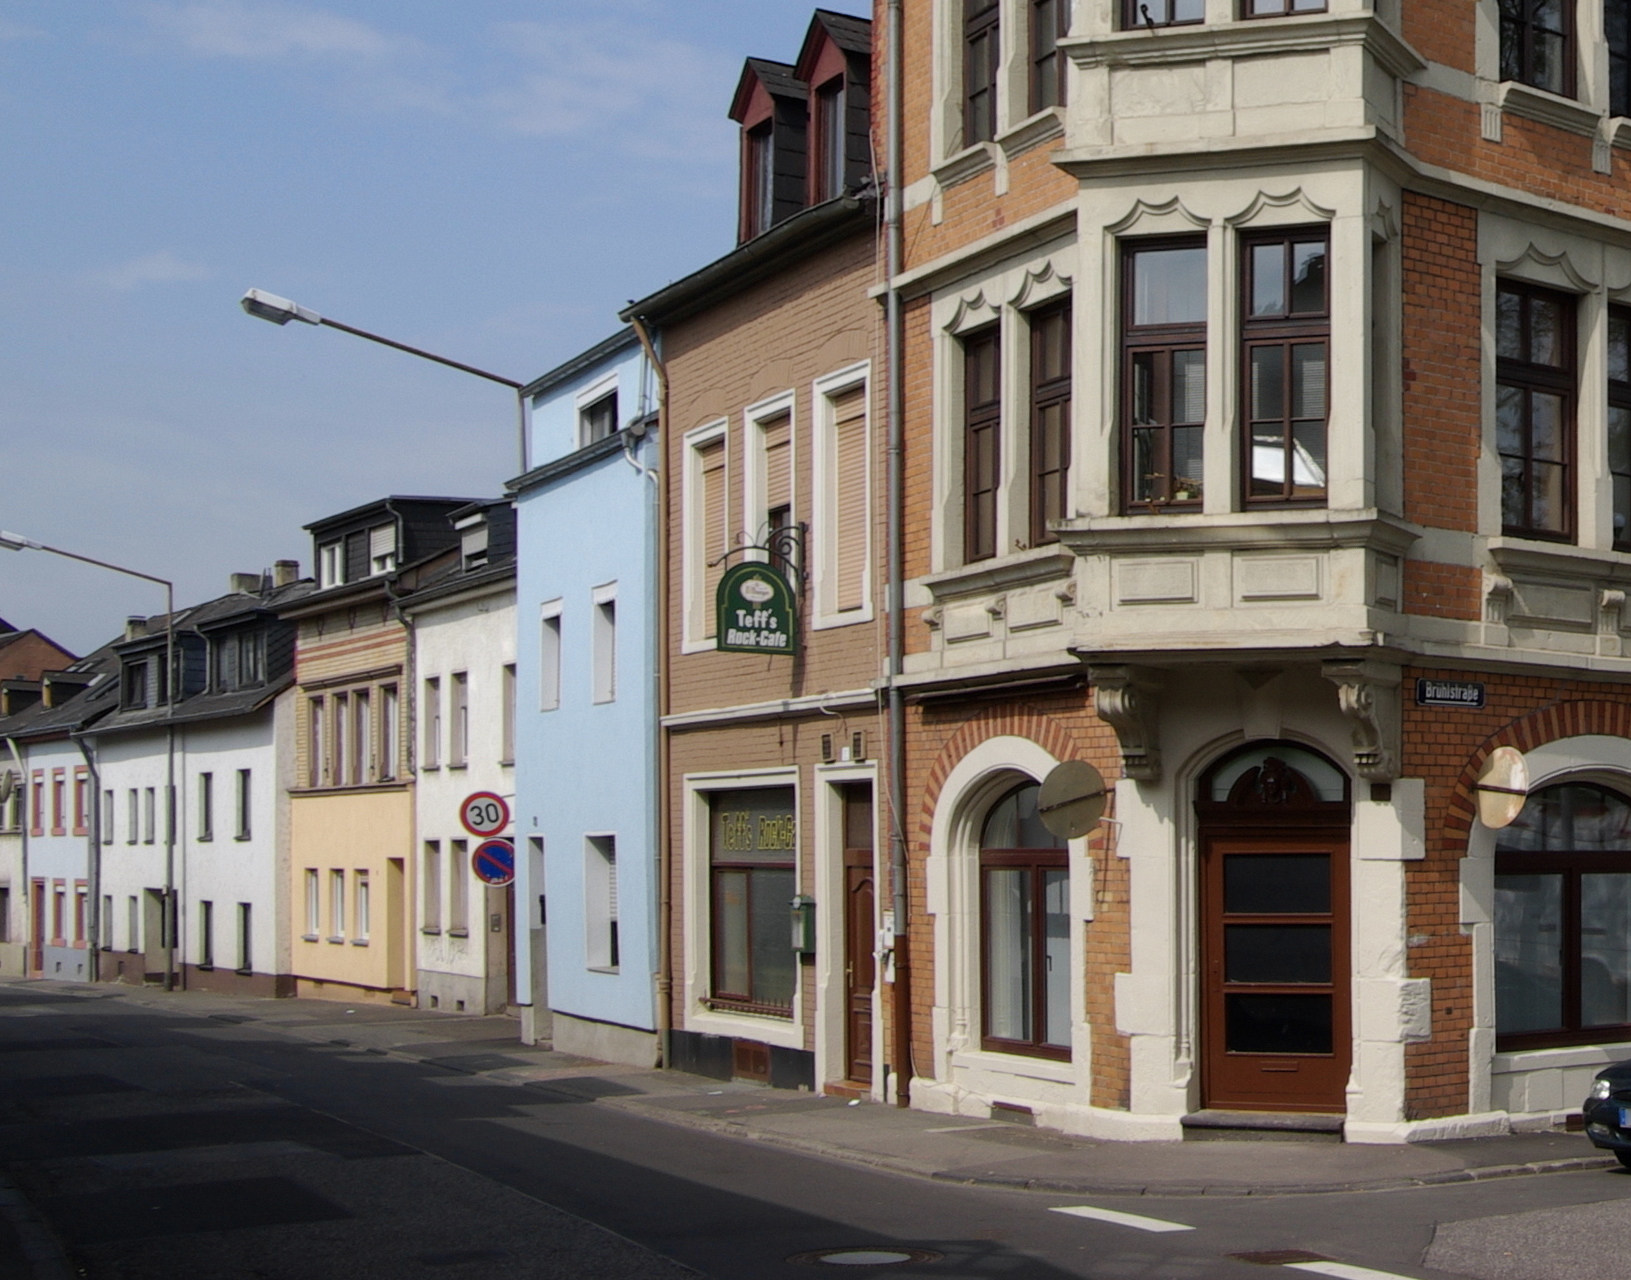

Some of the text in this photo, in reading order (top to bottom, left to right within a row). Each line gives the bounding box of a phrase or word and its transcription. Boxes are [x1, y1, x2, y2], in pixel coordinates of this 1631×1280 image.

[736, 608, 778, 630] Teff's
[1425, 681, 1479, 701] Brühlstraße
[469, 803, 500, 826] 30
